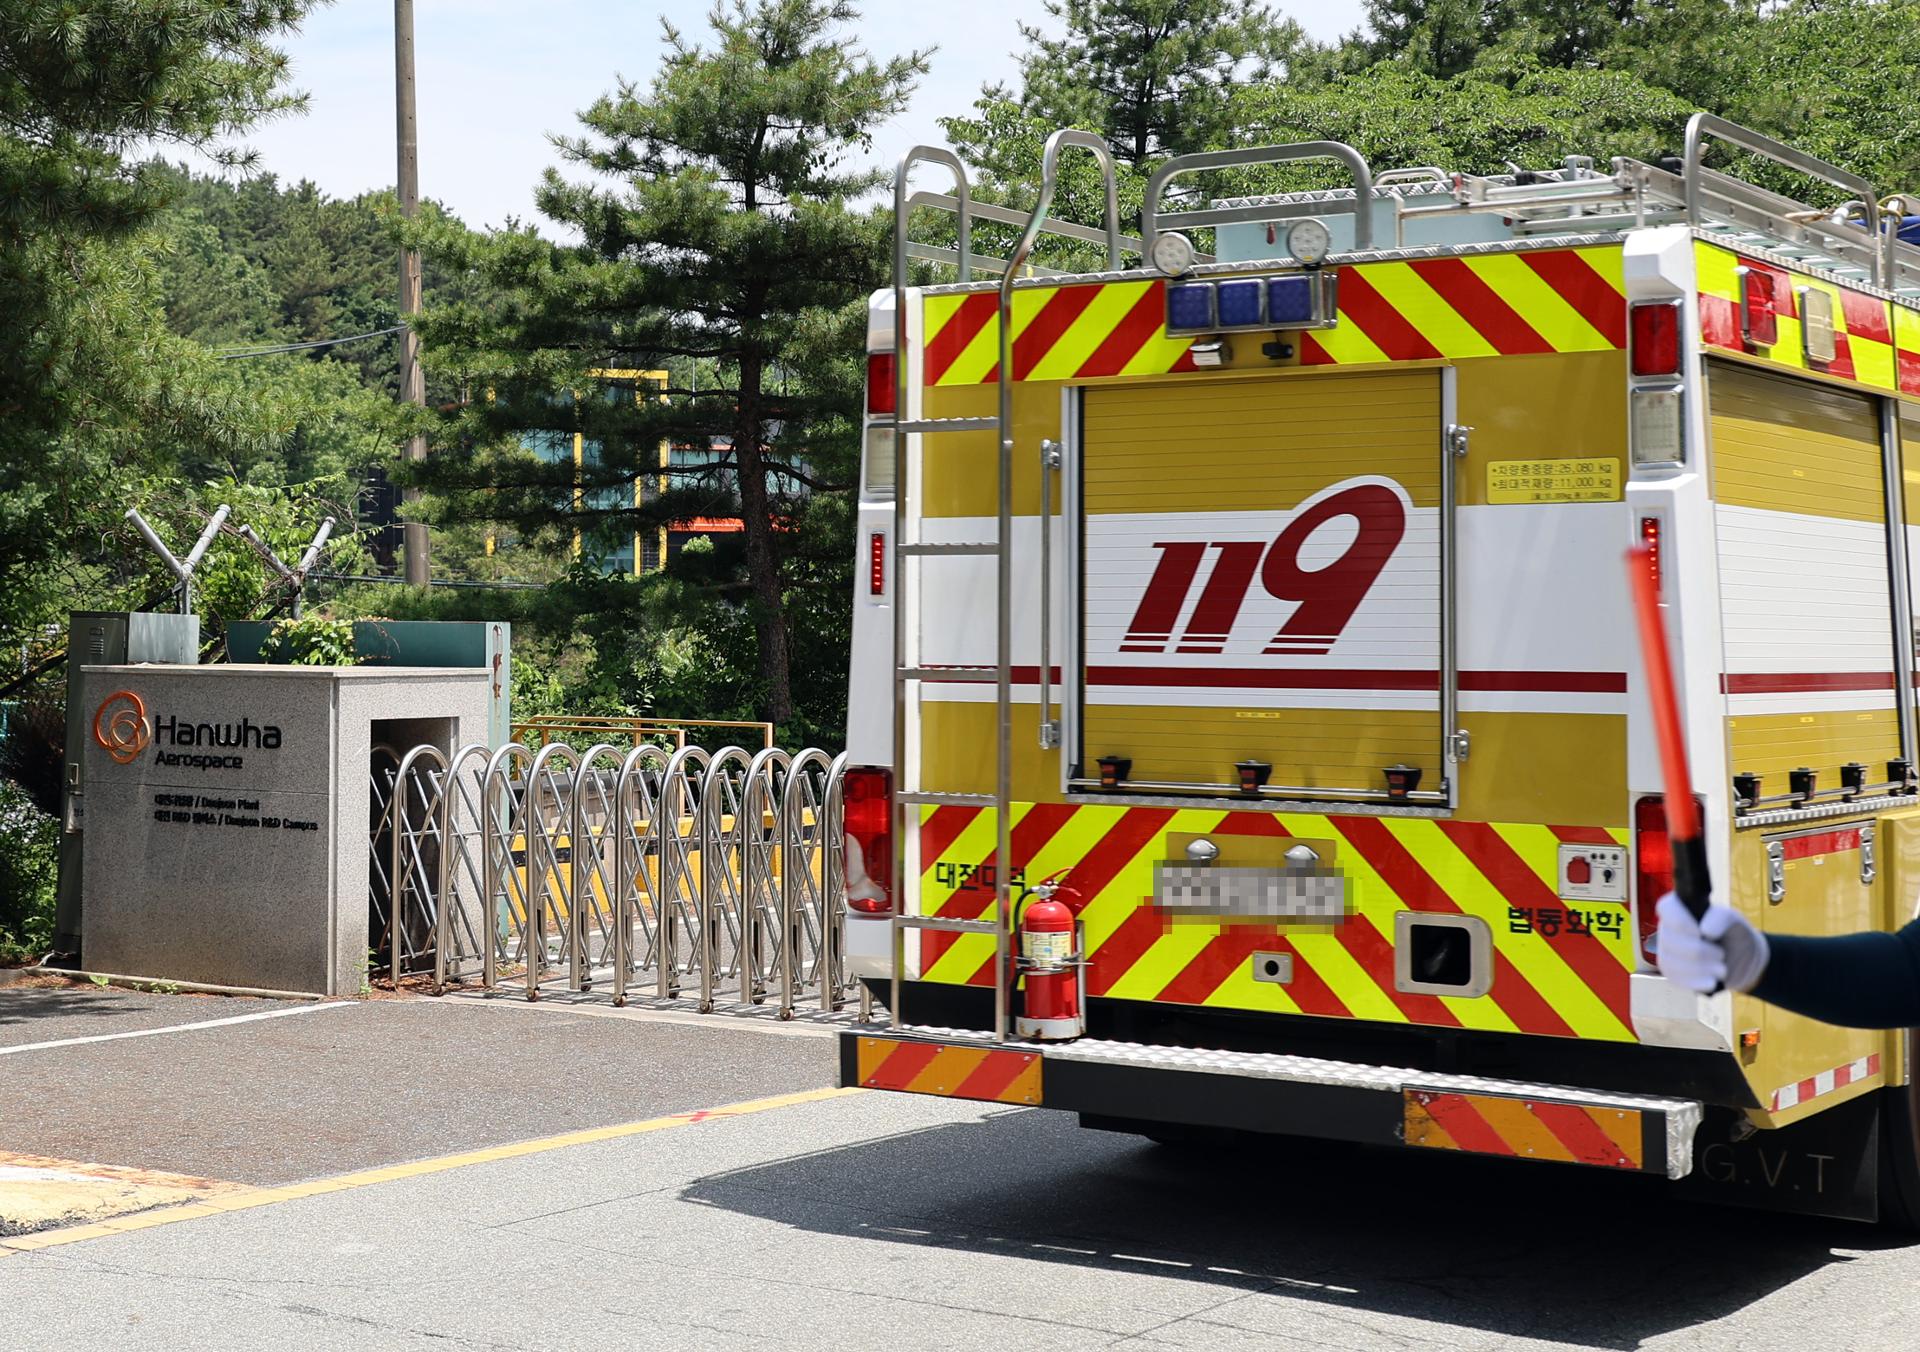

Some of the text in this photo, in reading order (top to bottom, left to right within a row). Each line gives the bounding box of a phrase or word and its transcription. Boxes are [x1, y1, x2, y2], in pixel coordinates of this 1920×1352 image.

[1118, 484, 1406, 654] 119
[155, 715, 282, 749] Hanwha
[155, 751, 243, 771] Aerospace
[1508, 906, 1625, 940] 법동화학
